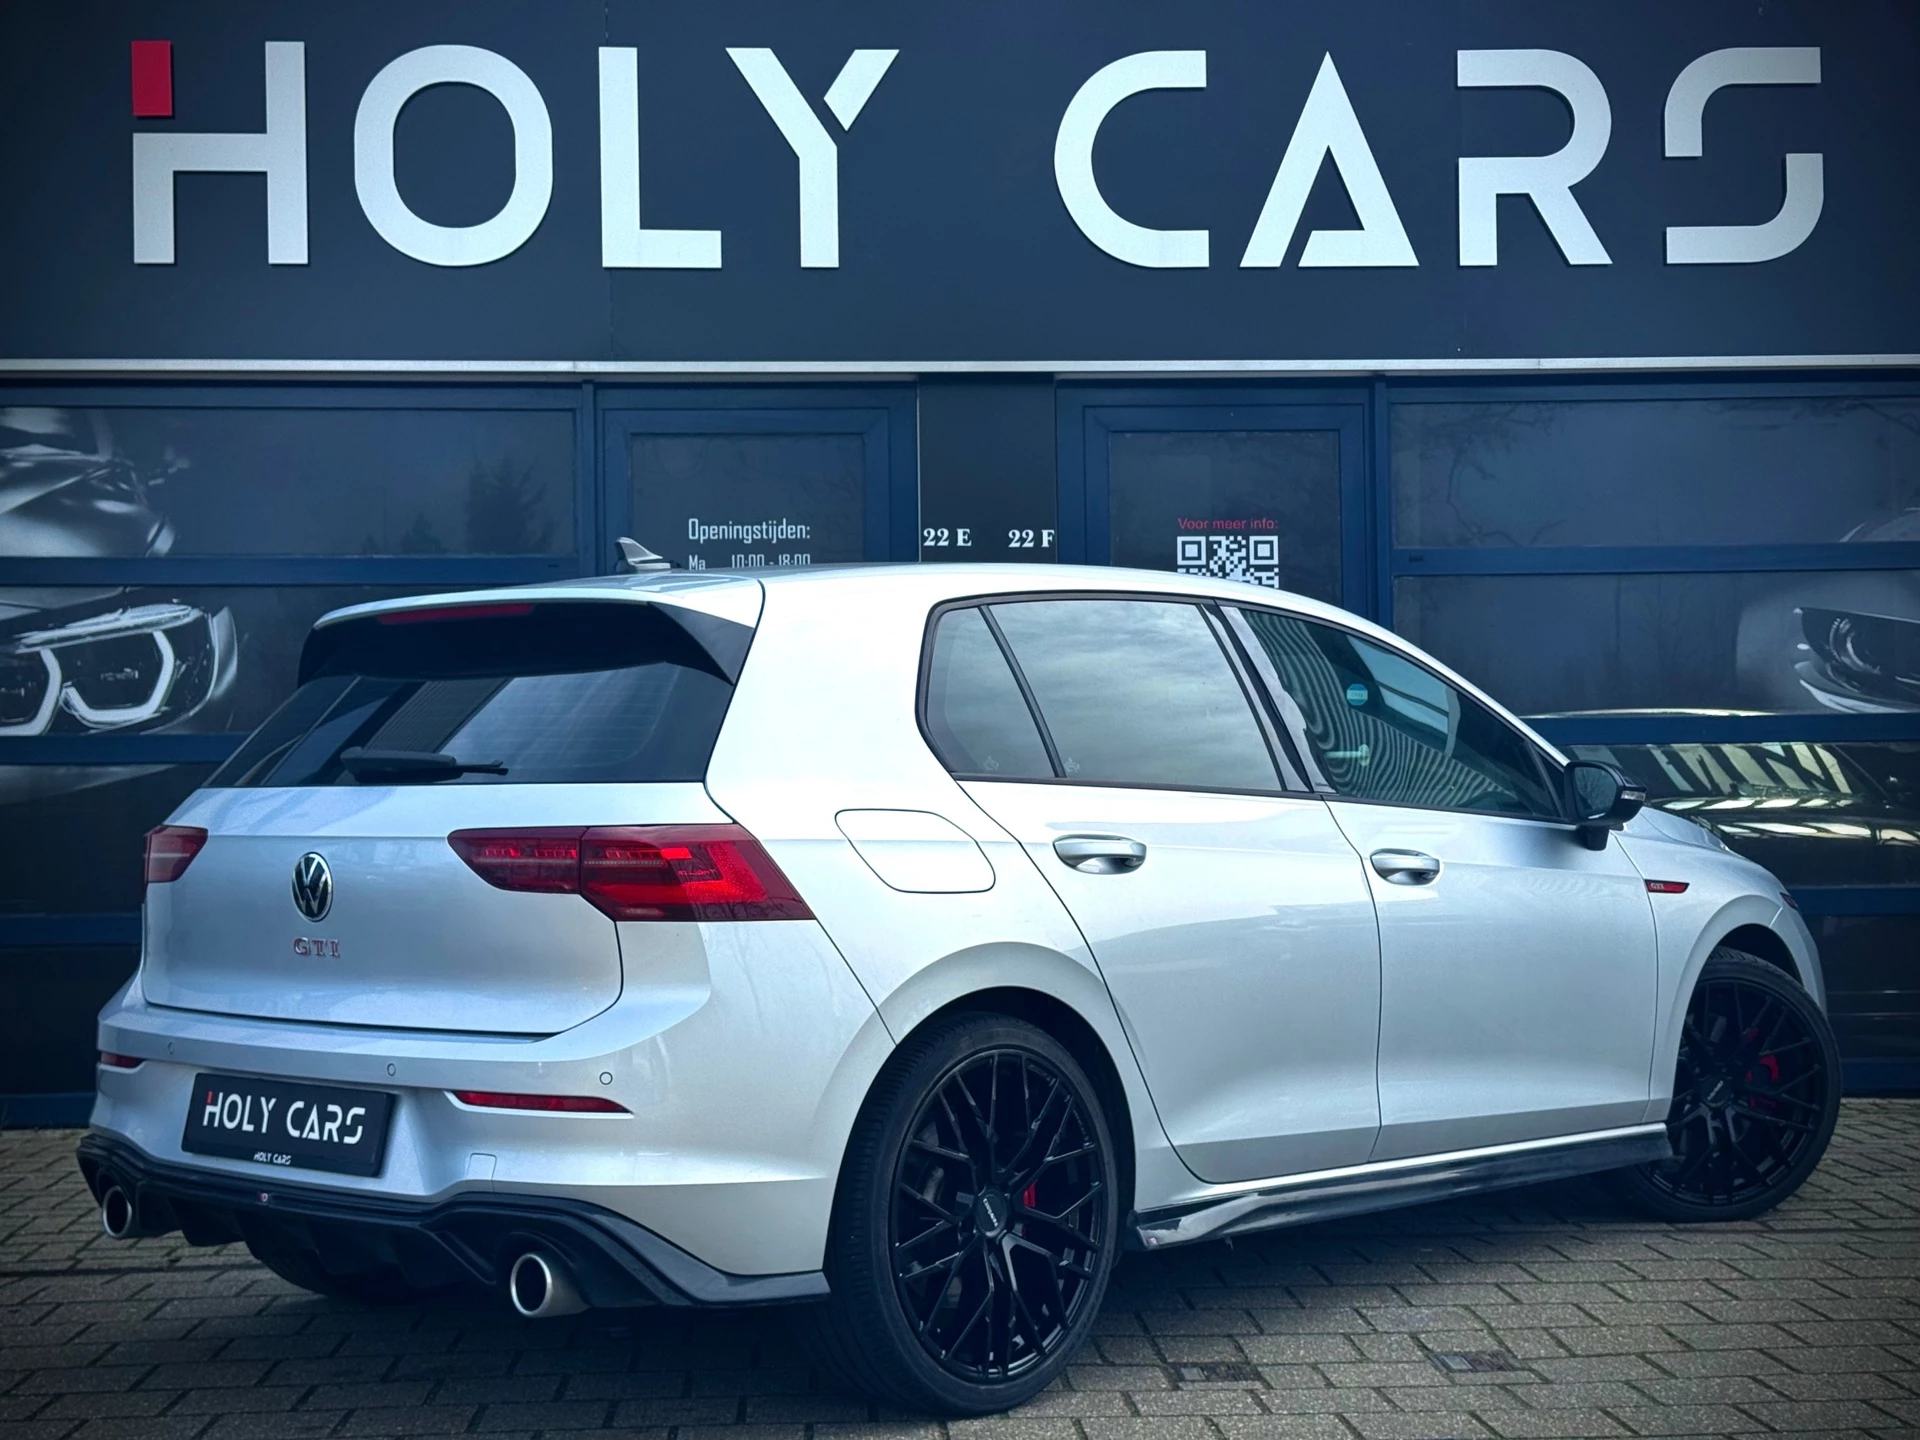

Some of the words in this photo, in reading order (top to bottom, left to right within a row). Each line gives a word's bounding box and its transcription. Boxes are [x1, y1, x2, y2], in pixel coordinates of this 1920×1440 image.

[131, 40, 900, 269] HOLY
[1054, 48, 1825, 269] CARS
[687, 517, 811, 544] Openingstijden:
[1178, 517, 1209, 530] Voor
[1212, 519, 1246, 530] meer
[1250, 517, 1279, 530] info:
[923, 527, 950, 547] 22
[956, 528, 972, 547] E
[1008, 529, 1035, 548] 22
[1041, 529, 1056, 548] F
[688, 553, 706, 571] Ma
[293, 937, 341, 958] GTI
[202, 1091, 277, 1134] HOLY
[286, 1100, 366, 1145] CARS
[253, 1151, 272, 1162] HOLY
[273, 1153, 292, 1165] CARS
